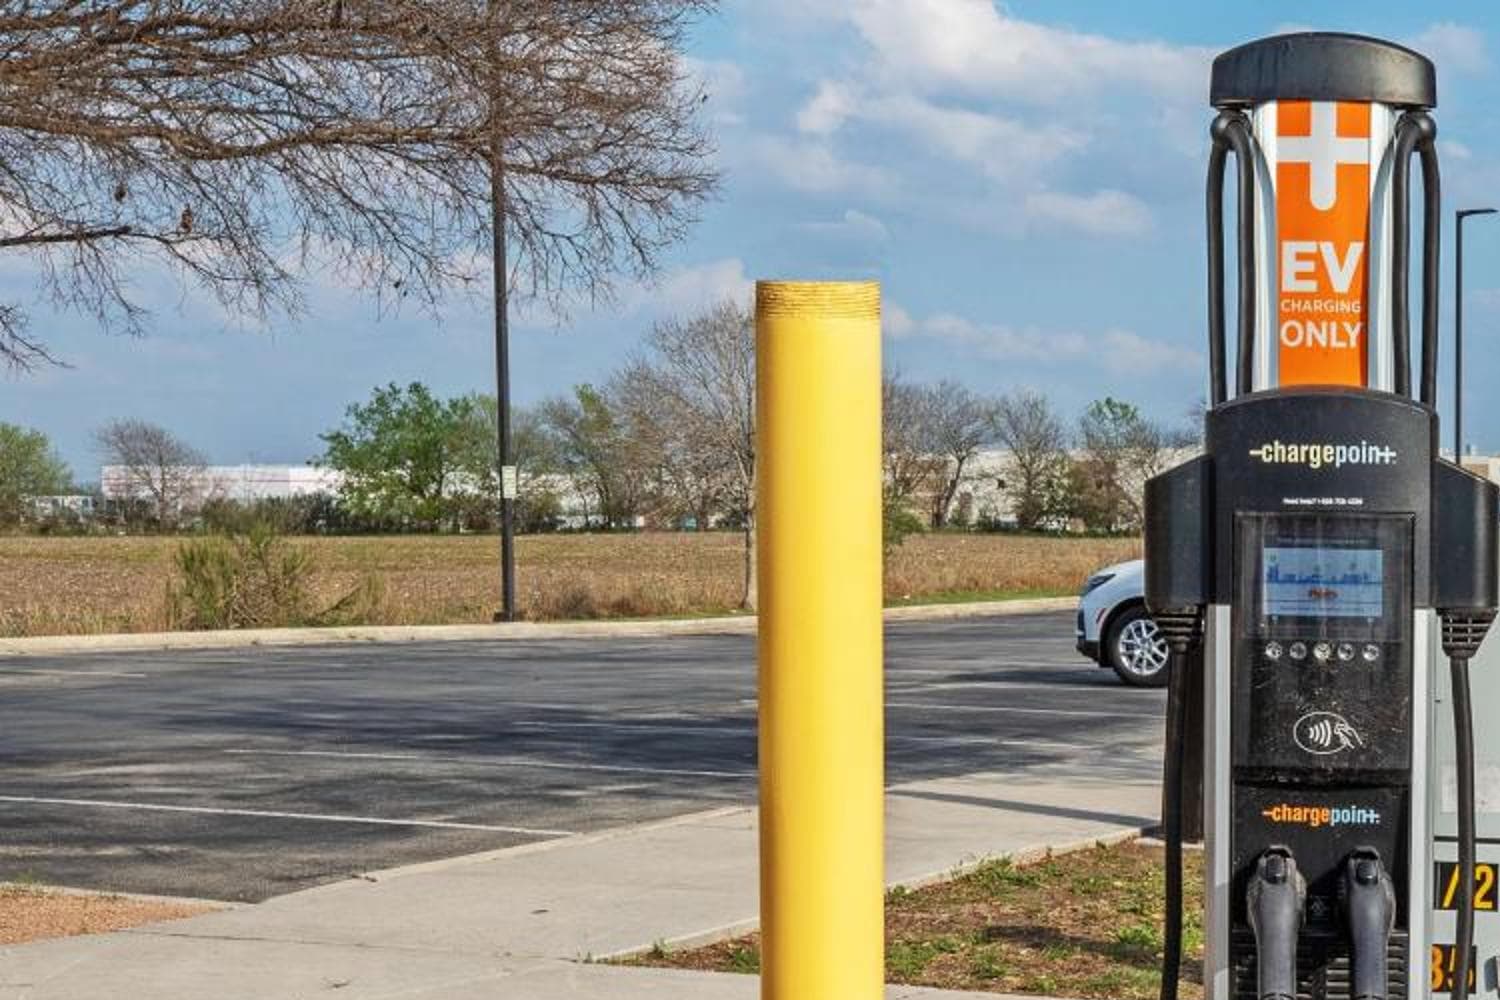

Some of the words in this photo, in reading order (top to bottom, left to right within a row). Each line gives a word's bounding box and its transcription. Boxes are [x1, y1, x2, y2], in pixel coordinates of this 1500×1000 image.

[1280, 241, 1365, 293] EV
[1280, 298, 1361, 314] CHARGING
[1280, 319, 1362, 349] ONLY
